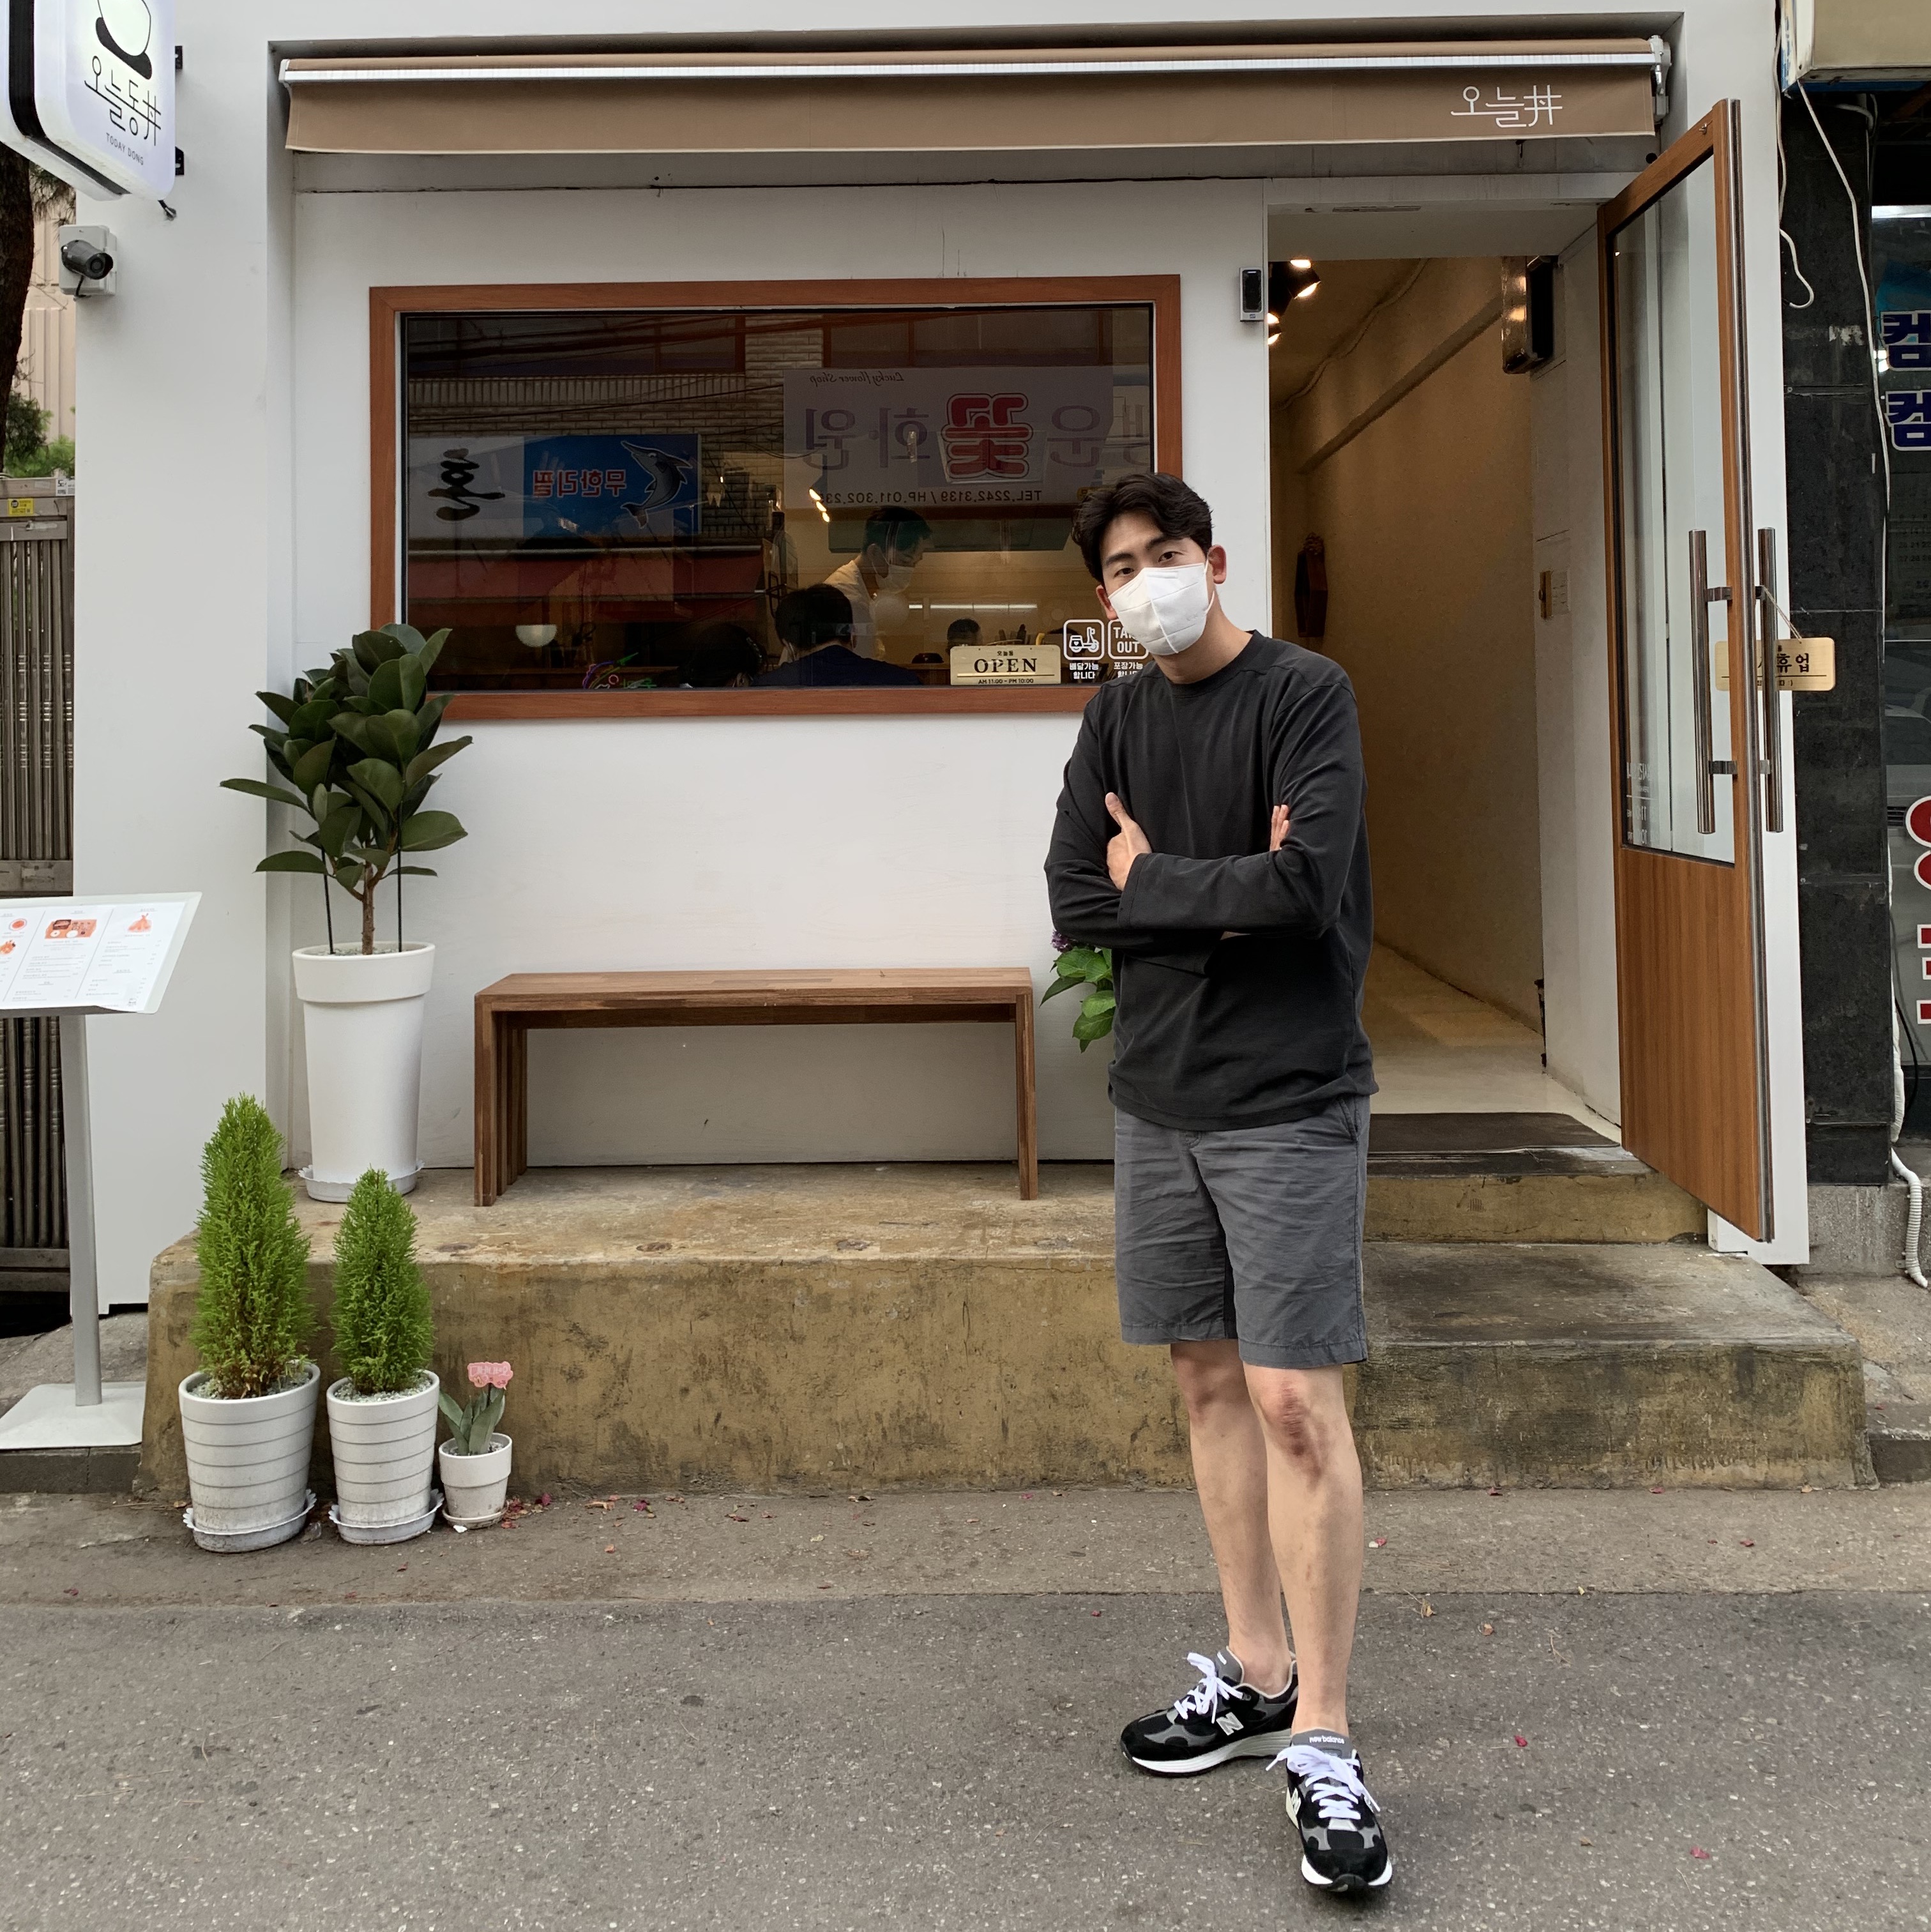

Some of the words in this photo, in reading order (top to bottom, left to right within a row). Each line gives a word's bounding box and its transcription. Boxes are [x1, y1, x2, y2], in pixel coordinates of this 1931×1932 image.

[106, 132, 125, 152] TODAY
[128, 147, 144, 165] DONG
[1113, 627, 1135, 639] TA
[1117, 641, 1140, 653] OUT
[974, 658, 1037, 673] OPEN
[1216, 1712, 1244, 1736] N
